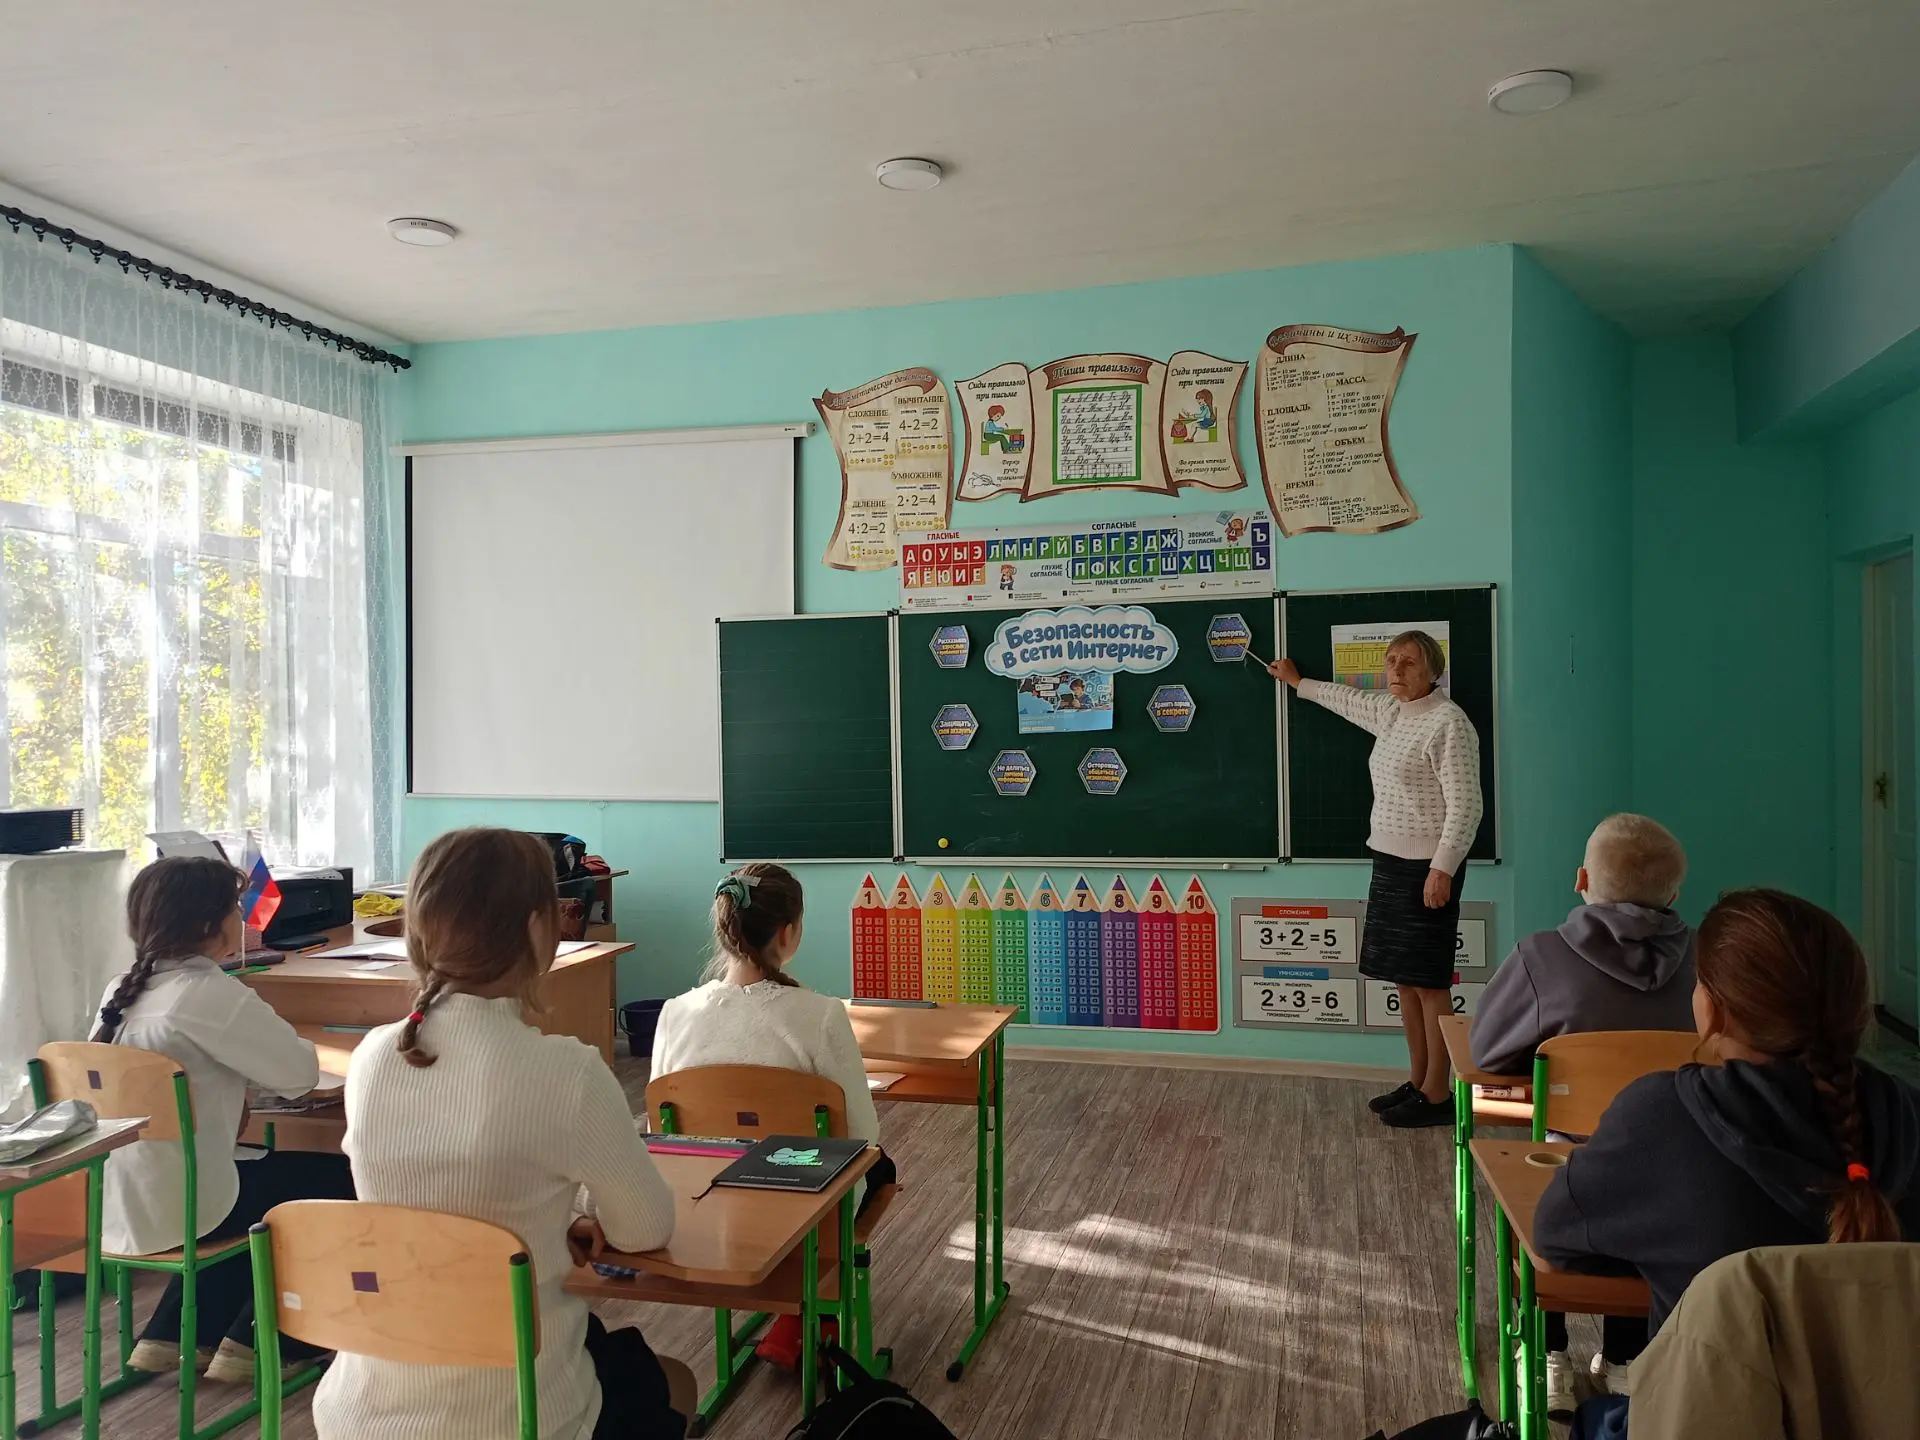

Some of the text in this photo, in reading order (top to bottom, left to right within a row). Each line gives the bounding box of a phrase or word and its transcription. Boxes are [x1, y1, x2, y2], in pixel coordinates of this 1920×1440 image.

[1276, 354, 1305, 364] ДЛИНА
[1054, 364, 1142, 378] Пиши правильно
[1171, 366, 1233, 377] Сиди правильно
[968, 379, 1025, 390] Сиди правильно
[1179, 380, 1192, 389] при
[1335, 376, 1366, 387] МАССА
[976, 391, 1017, 402] при письме
[848, 410, 888, 418] СЛОЖЕНИЕ
[1267, 404, 1310, 416] ПЛОЩАДЬ
[1334, 437, 1365, 446] ОБЪЕМ
[893, 472, 942, 480] УМНОЖЕНИЕ
[1285, 479, 1315, 490] ВРЕМЯ
[852, 500, 886, 508] ДЕЛЕНИЕ
[1091, 521, 1137, 531] СОГЛАСНЫЕ
[927, 532, 959, 541] ГЛАСНЫЕ
[906, 529, 1267, 563] А О У Ы Э Л М Н Р Й Б В Г З Д Ж Ъ
[907, 552, 1266, 584] Я Ё Ю И Е П Ф К С Т Ш Х Ц Ч Щ Ь
[1030, 570, 1063, 578] СОГЛАСНЫЕ
[1120, 577, 1153, 585] СОГЛАСНЫЕ
[1004, 623, 1155, 649] Безопасность
[1020, 644, 1063, 663] сети
[1067, 641, 1168, 662] Интернет
[864, 891, 1204, 909] 1 2 3 4 5 6 7 8 9 10
[1260, 928, 1336, 946] 3 + 2 = 5
[1261, 989, 1274, 1006] 2
[1292, 990, 1306, 1008] 3
[1312, 996, 1321, 1004] =
[1326, 992, 1338, 1009] 6
[1386, 994, 1400, 1012] 6
[1452, 996, 1466, 1014] 2
